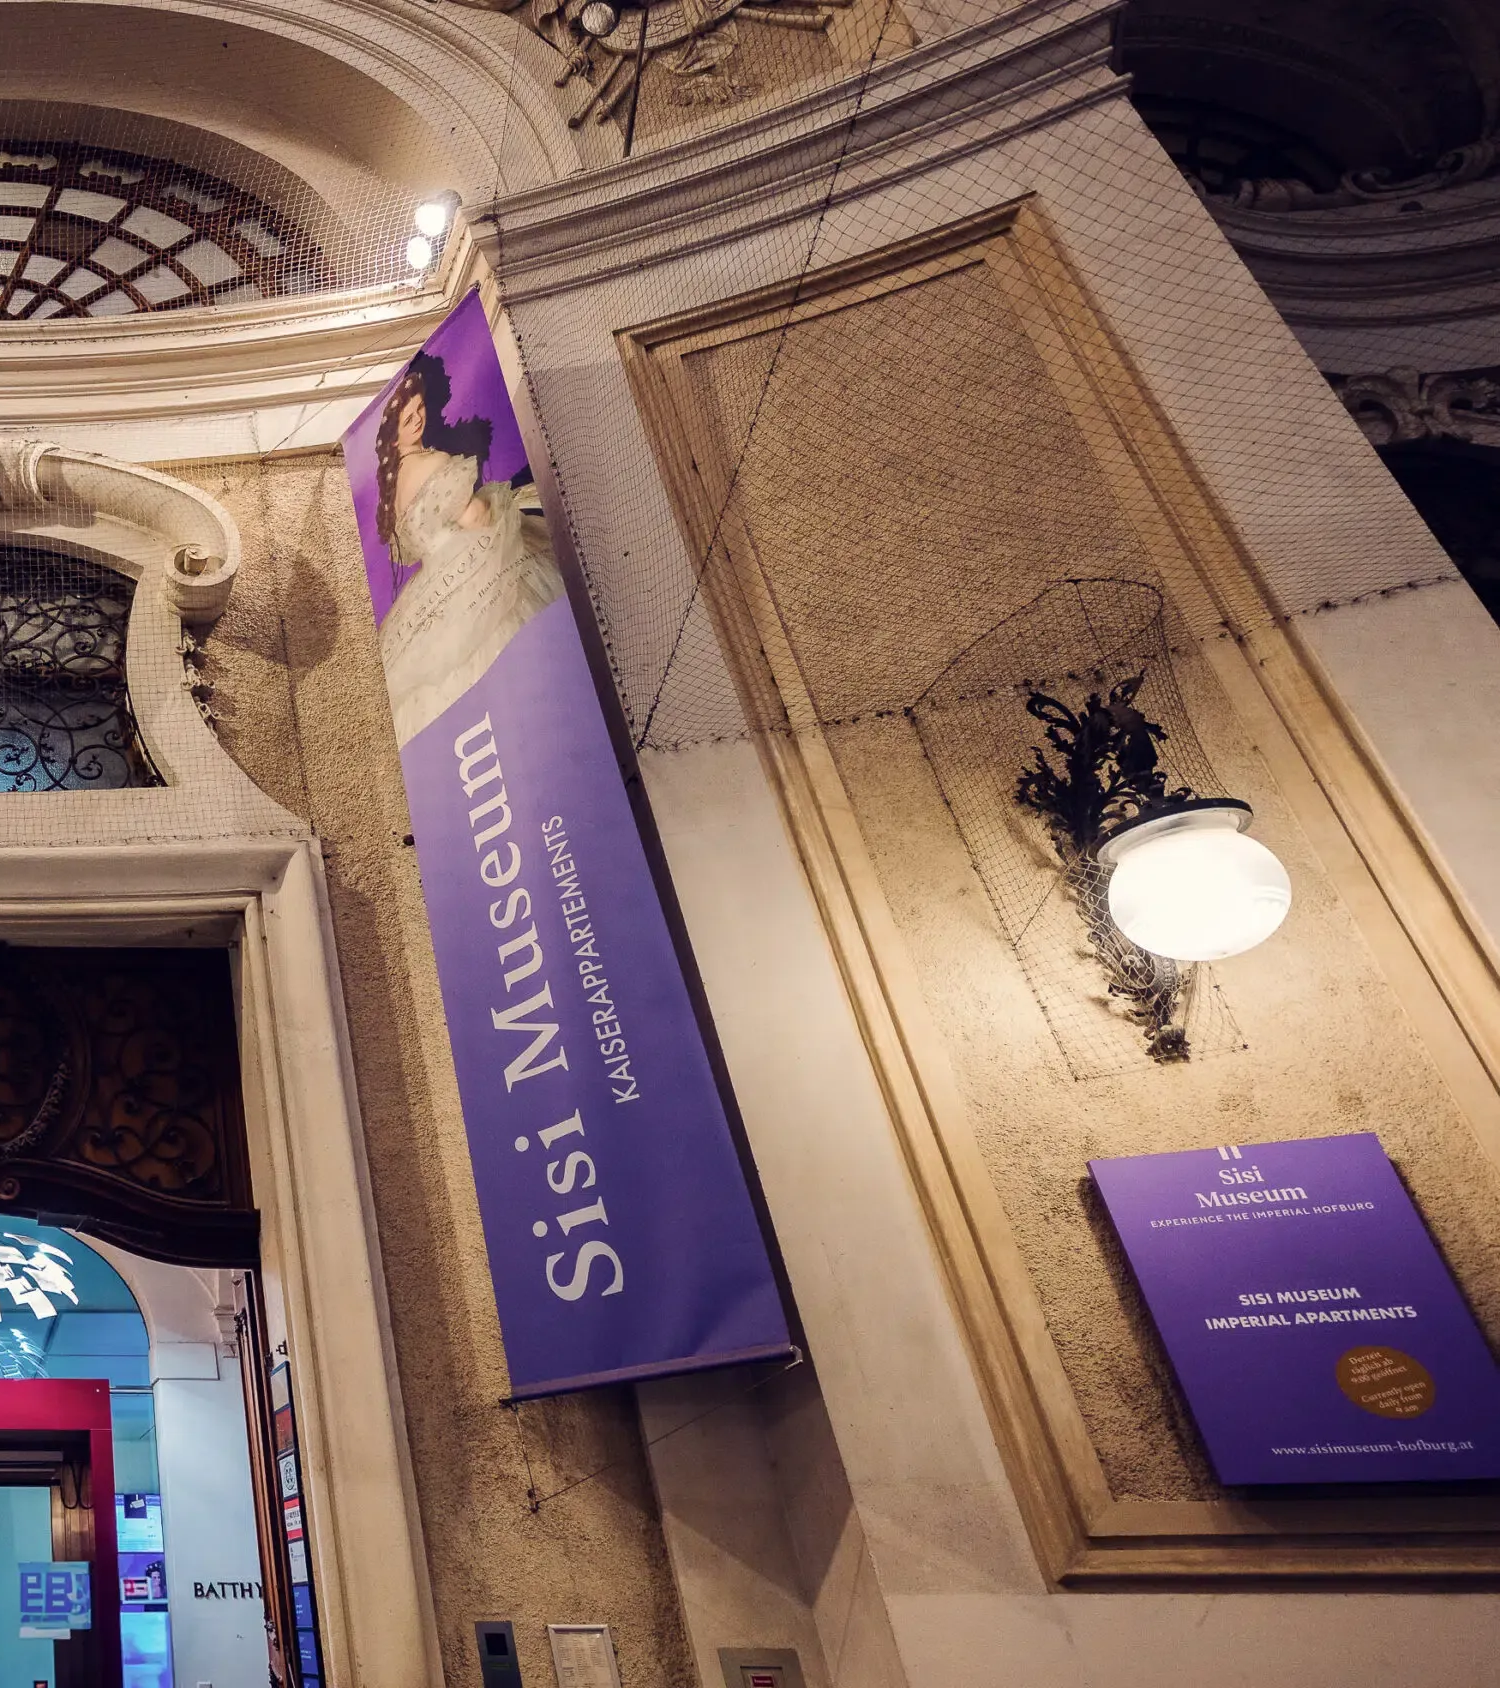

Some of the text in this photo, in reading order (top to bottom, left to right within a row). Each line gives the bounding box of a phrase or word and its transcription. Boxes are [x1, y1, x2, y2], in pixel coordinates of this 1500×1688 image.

[454, 711, 569, 1093] Museum
[541, 815, 640, 1104] KAISERAPPARTEMENTS
[1218, 1165, 1265, 1186] Sisi
[515, 1108, 624, 1301] Sisi
[1195, 1184, 1308, 1209] Museum
[1150, 1201, 1375, 1229] EXPERIENCE THE IMPERIAL HOFBURG
[1238, 1287, 1362, 1307] SISI MUSEUM
[1204, 1306, 1418, 1331] IMPERIAL APARTMENTS
[1403, 1382, 1426, 1392] open
[1271, 1439, 1474, 1458] www.sisimuseum-hofburg.at
